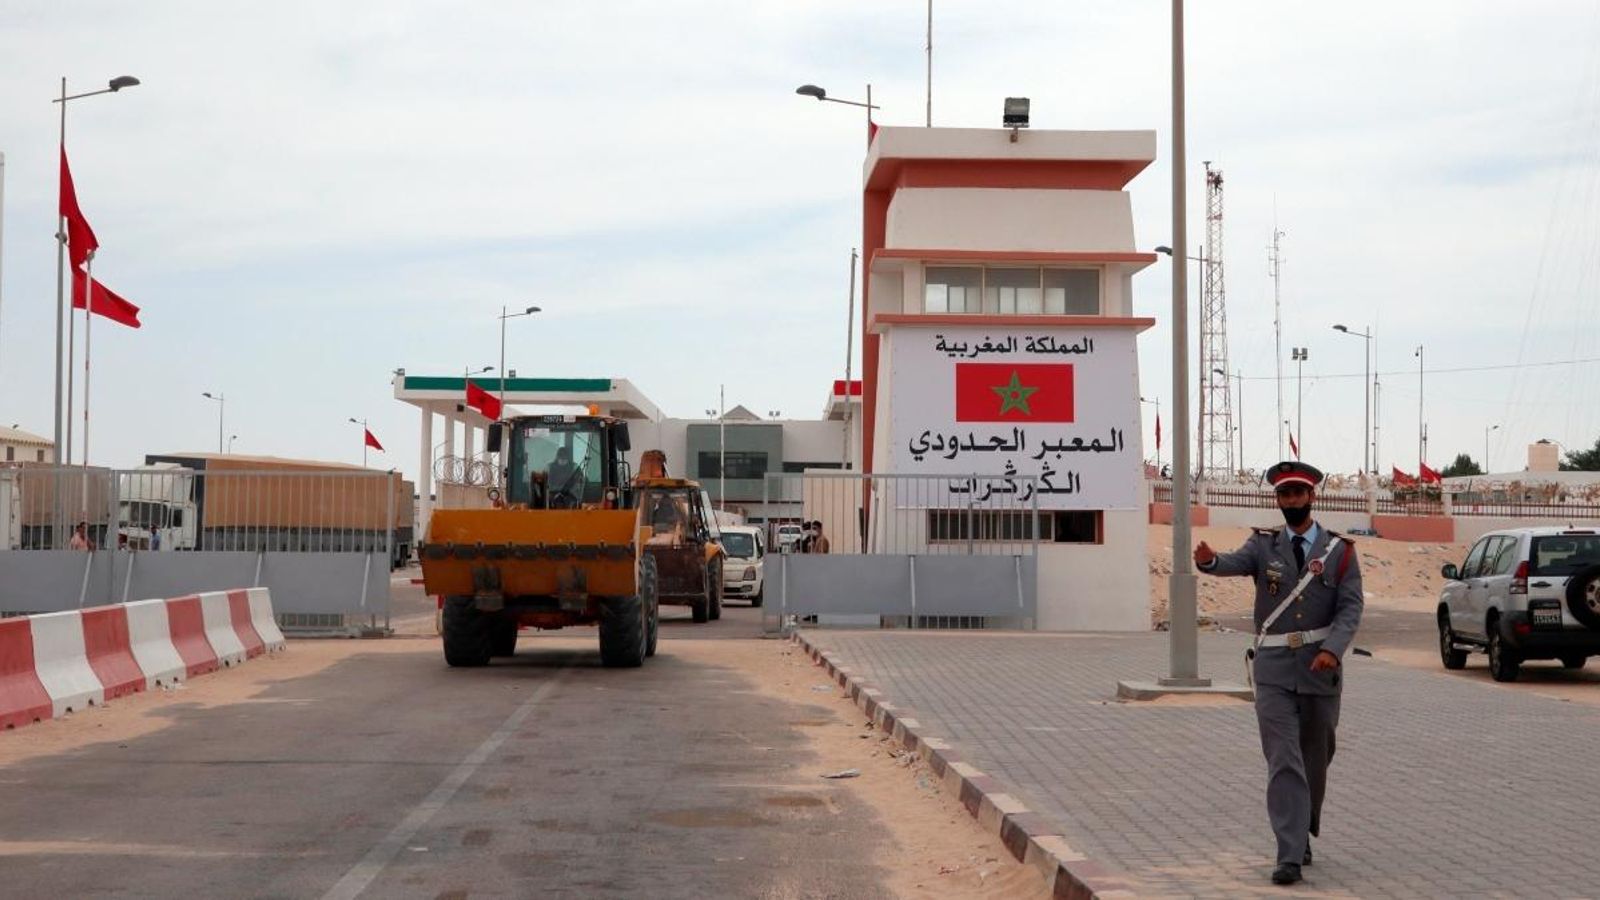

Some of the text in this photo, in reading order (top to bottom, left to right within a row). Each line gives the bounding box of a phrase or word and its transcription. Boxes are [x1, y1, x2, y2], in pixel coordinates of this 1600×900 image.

[935, 334, 1094, 358] المملكة المغربية
[909, 427, 1124, 462] المعبر الحدودي
